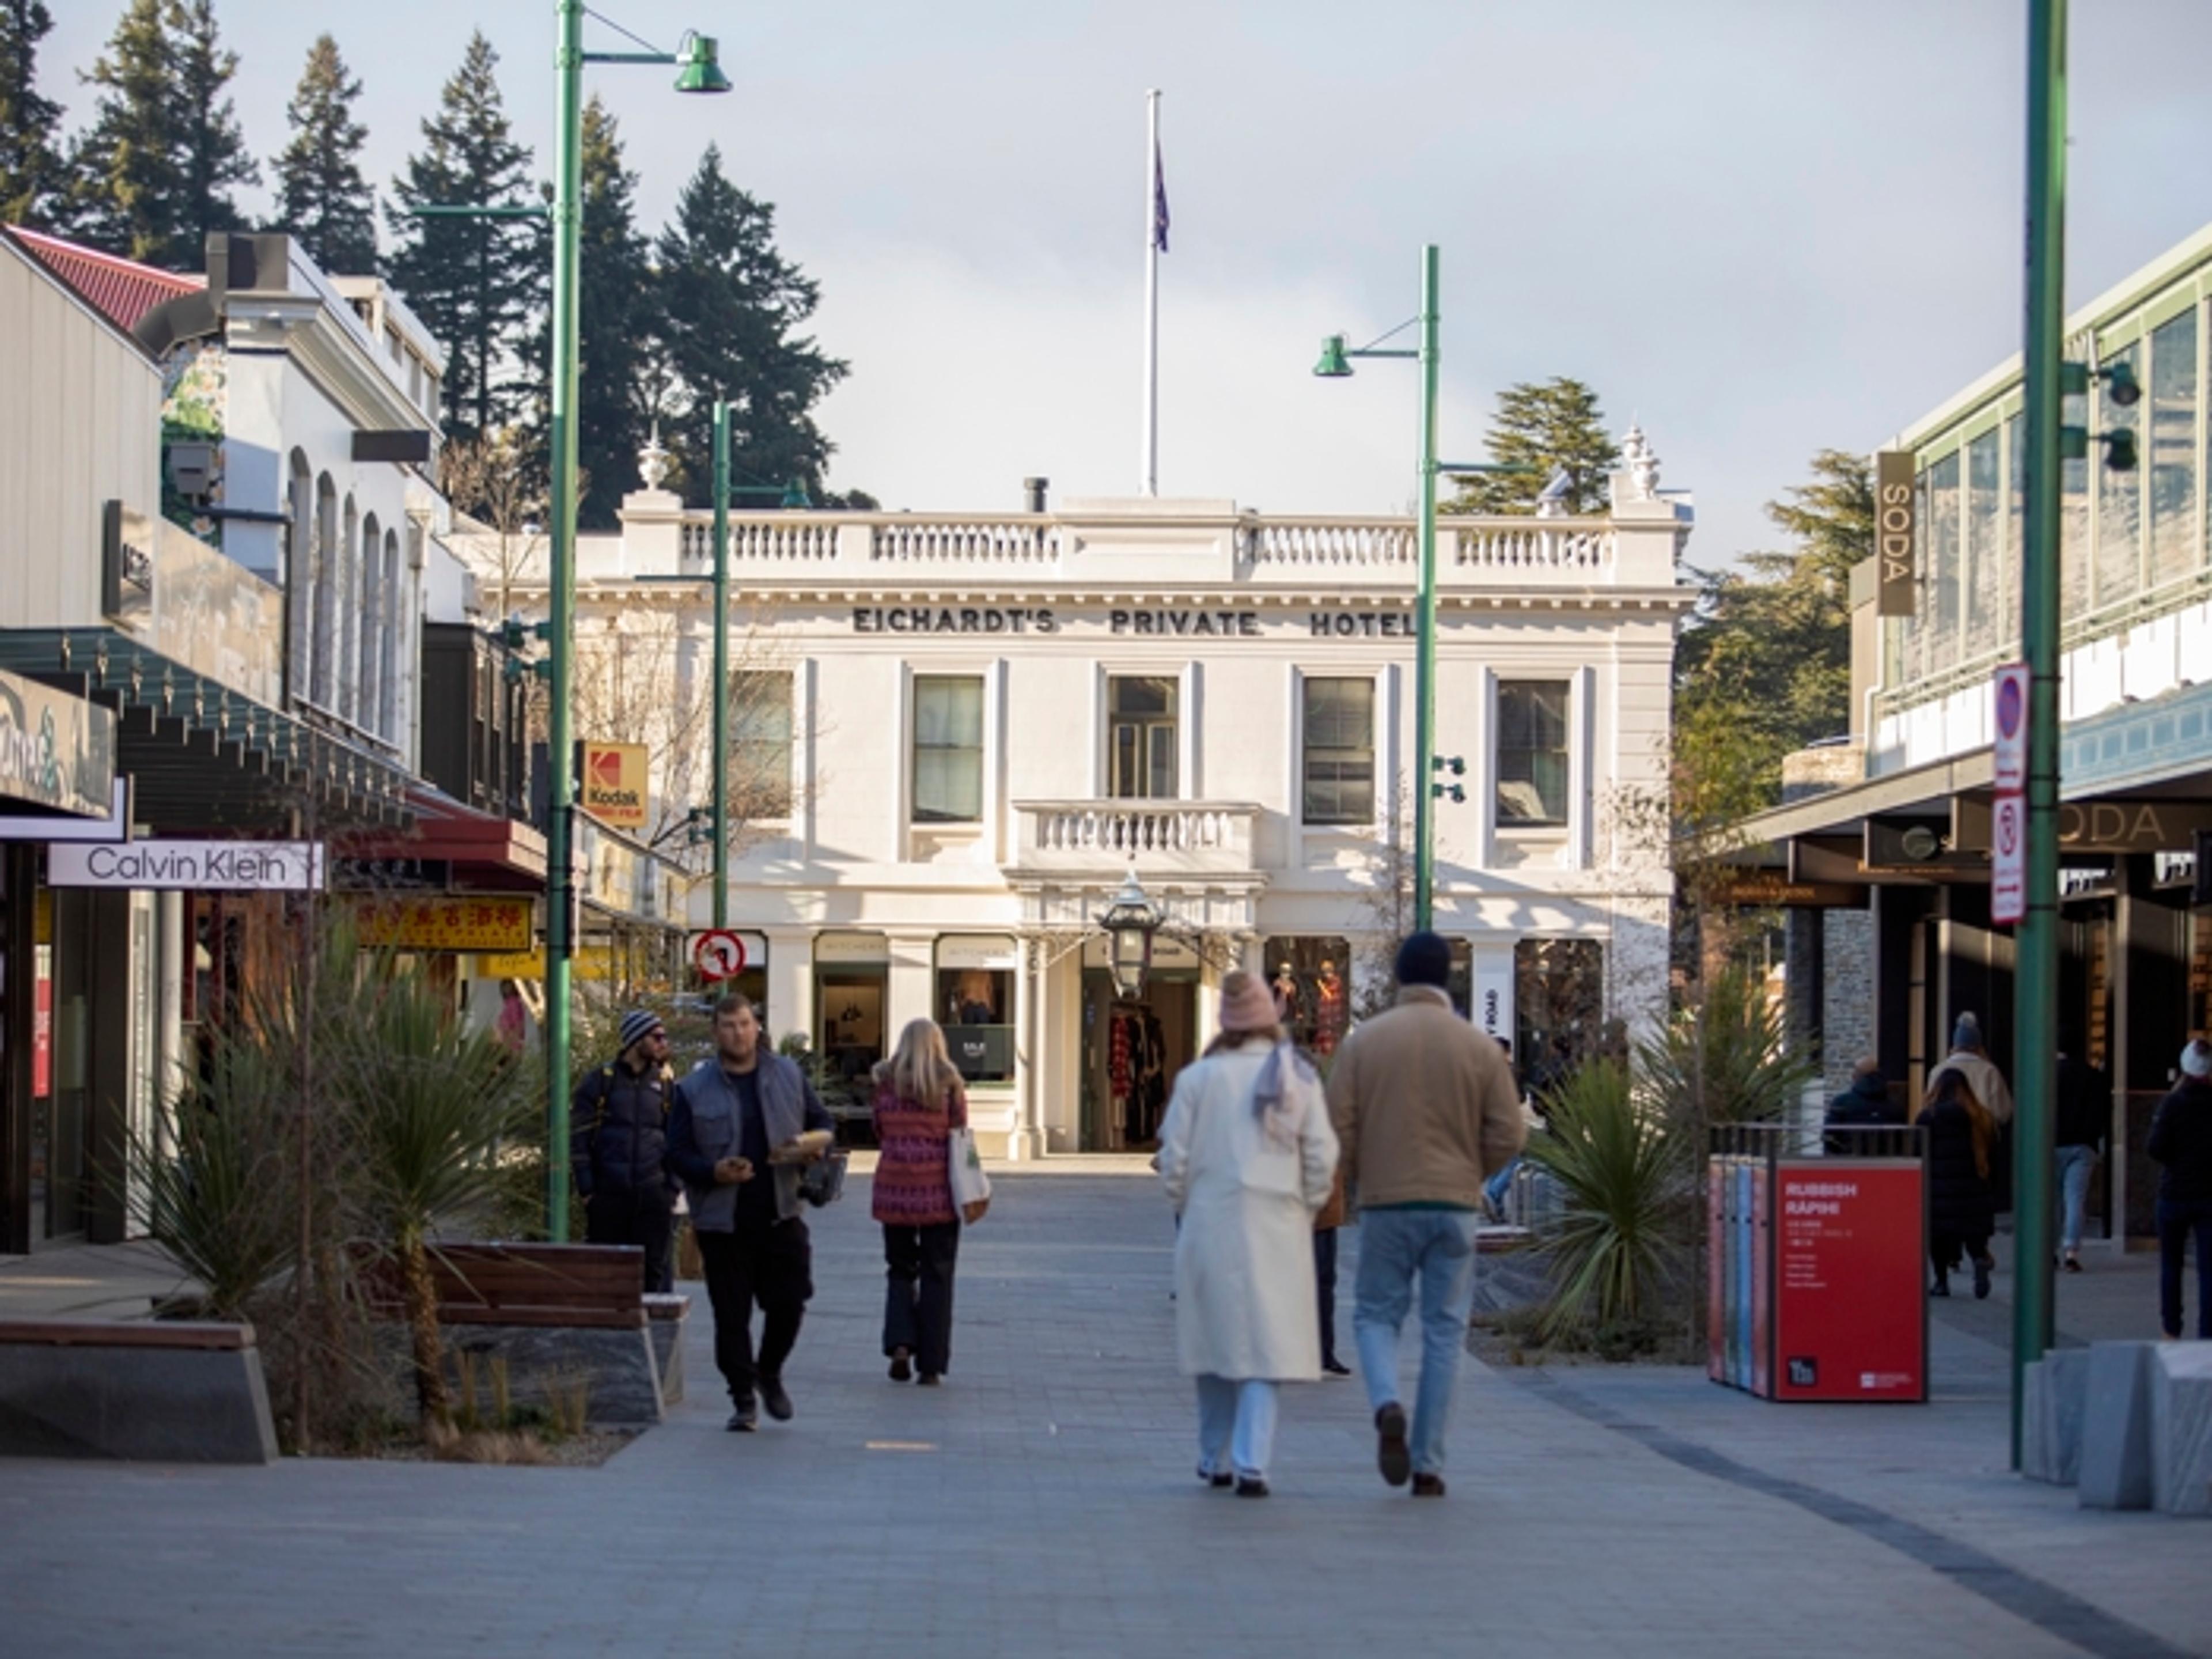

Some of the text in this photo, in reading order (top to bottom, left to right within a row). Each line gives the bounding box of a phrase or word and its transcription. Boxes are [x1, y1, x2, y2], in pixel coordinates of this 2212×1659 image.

[1882, 483, 1910, 584] SODA
[853, 608, 1418, 637] EICHARDT'S PRIVATE HOTEL
[588, 787, 639, 806] Kodak
[2059, 803, 2165, 842] ODA
[88, 846, 286, 881] Calvin Klein
[1486, 988, 1498, 1025] ROAD
[1786, 1183, 1858, 1197] RUBBISH
